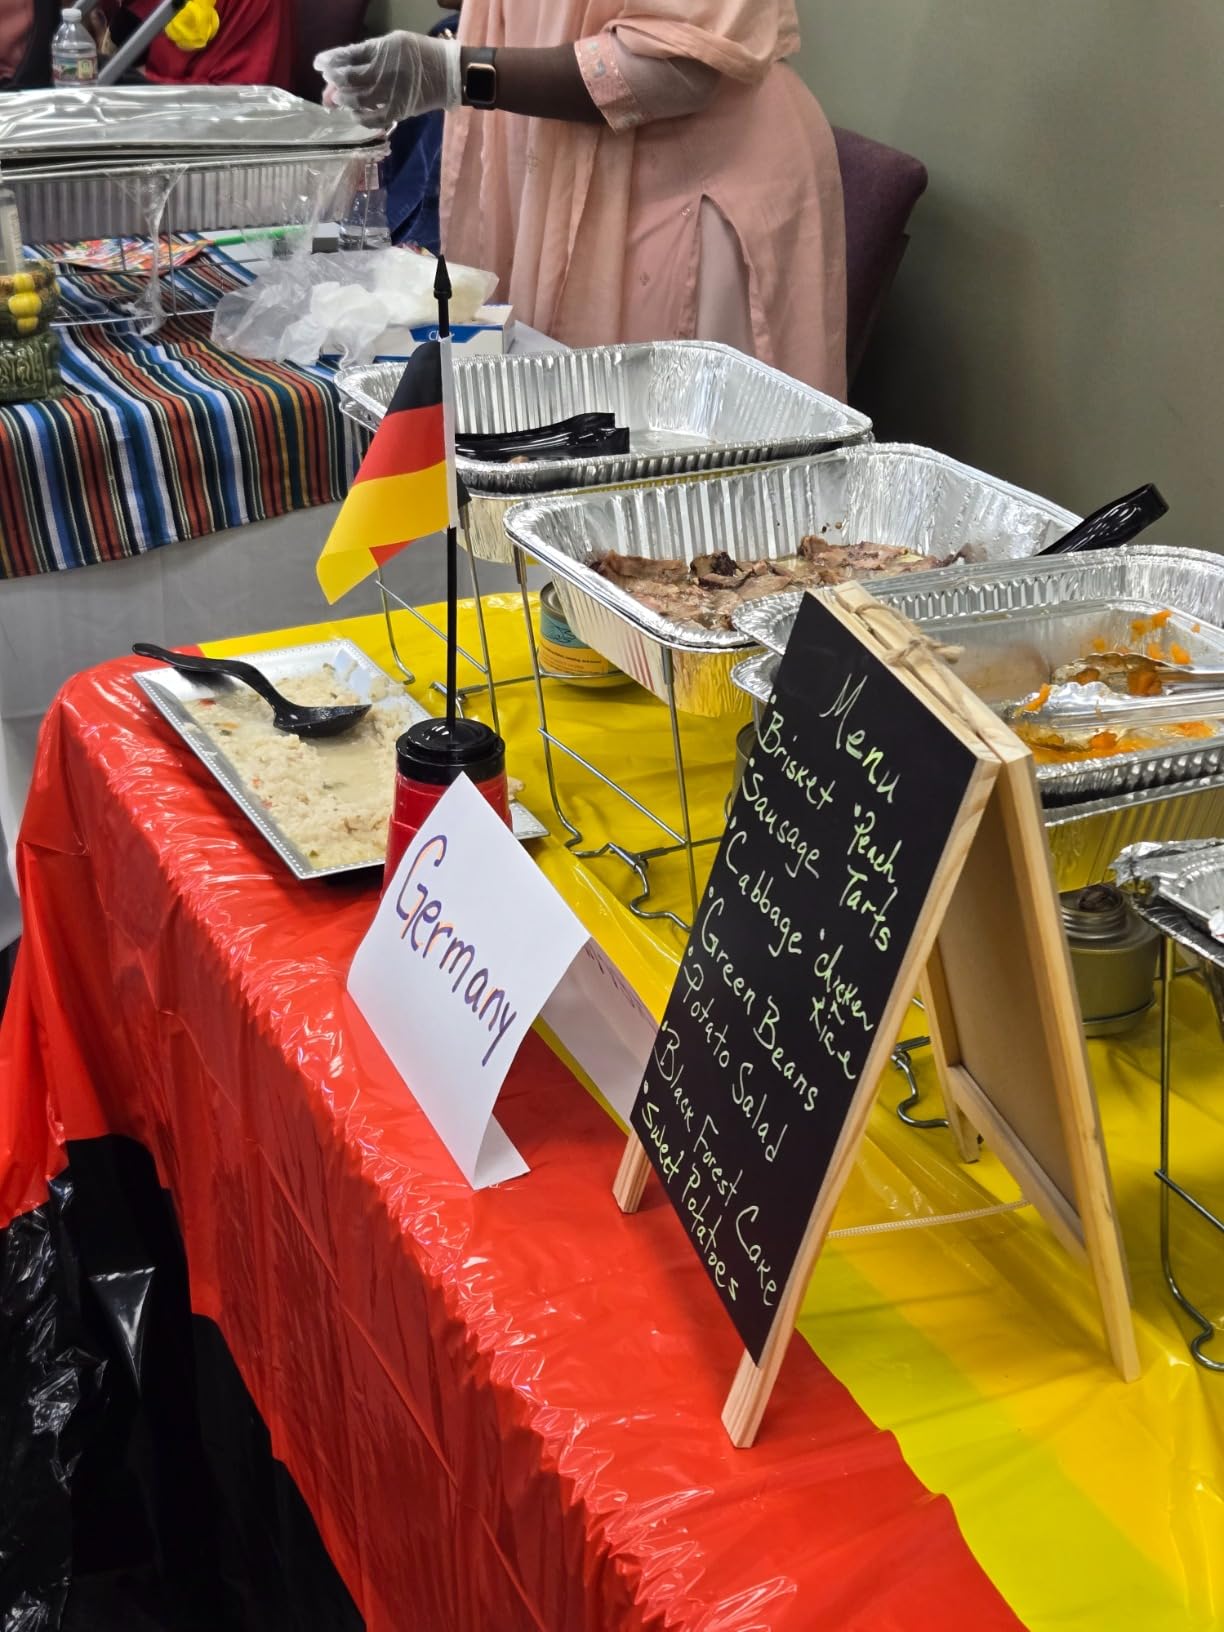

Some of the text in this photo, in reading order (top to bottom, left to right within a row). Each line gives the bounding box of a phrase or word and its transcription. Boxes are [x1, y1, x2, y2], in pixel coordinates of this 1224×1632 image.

[759, 710, 836, 810] Brisket
[819, 673, 901, 803] Menu
[742, 772, 820, 879] Sausage
[847, 810, 903, 884] Peach
[395, 833, 518, 1067] Germany
[725, 830, 803, 957] Cabbage
[839, 864, 899, 951] Tarts
[683, 962, 789, 1163] Potato Salad
[701, 897, 819, 1112] Green Beans
[641, 1101, 740, 1302] Sweet Potatoes
[653, 1027, 778, 1306] Black Forest Cake
